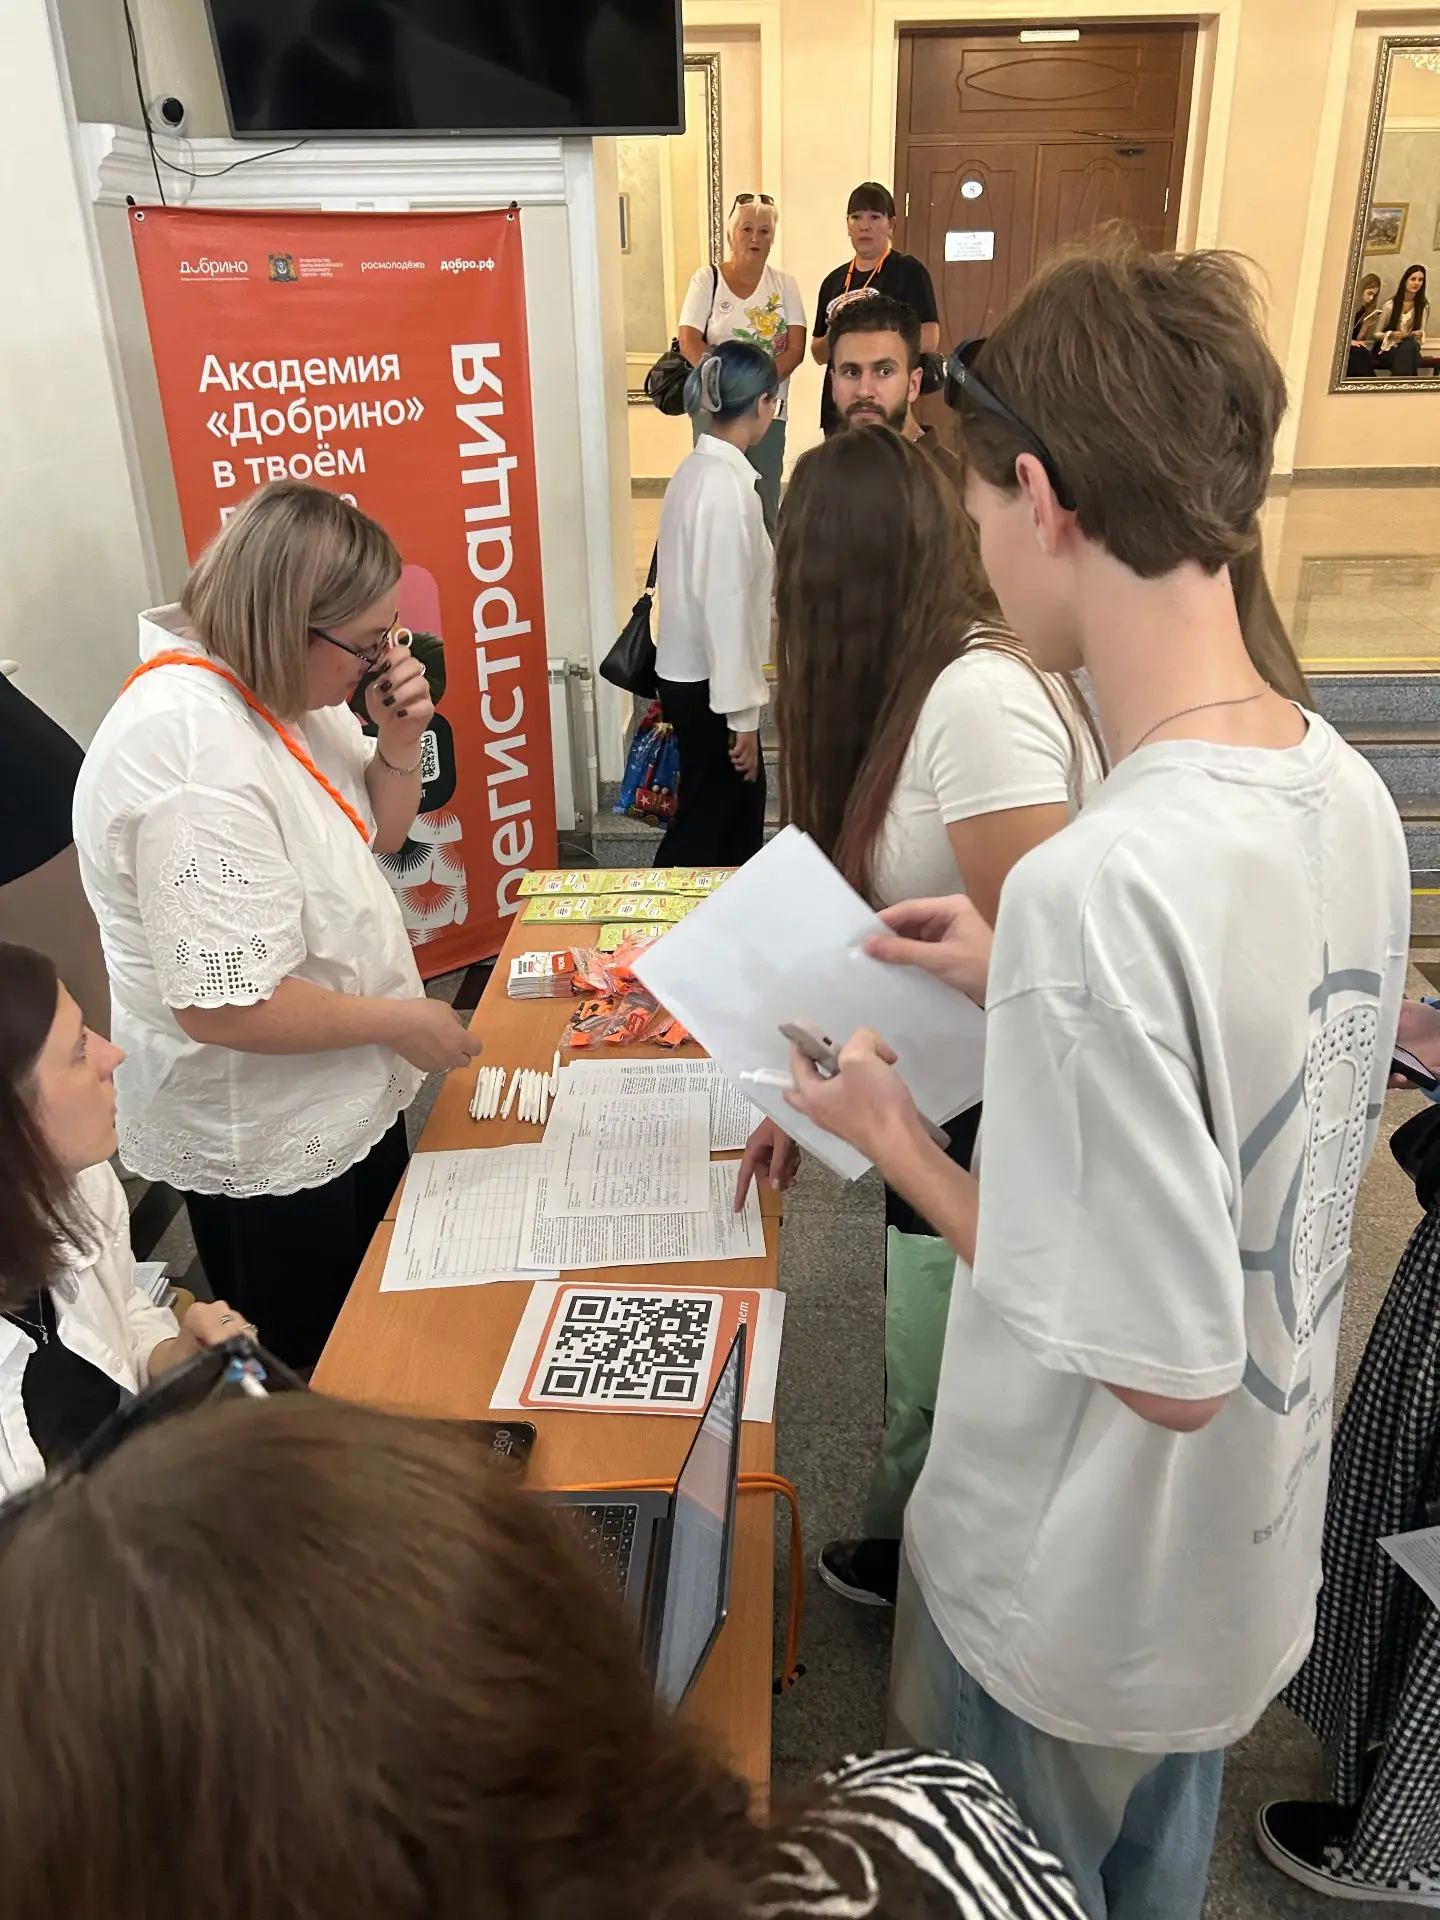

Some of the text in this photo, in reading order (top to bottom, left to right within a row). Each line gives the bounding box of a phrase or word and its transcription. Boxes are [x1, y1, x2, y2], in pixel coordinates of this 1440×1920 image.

[361, 261, 425, 272] росмолодёжь
[441, 257, 495, 272] добро.рф
[199, 354, 401, 394] Академия
[206, 396, 425, 447] «Добрино»
[212, 442, 366, 489] в твоём
